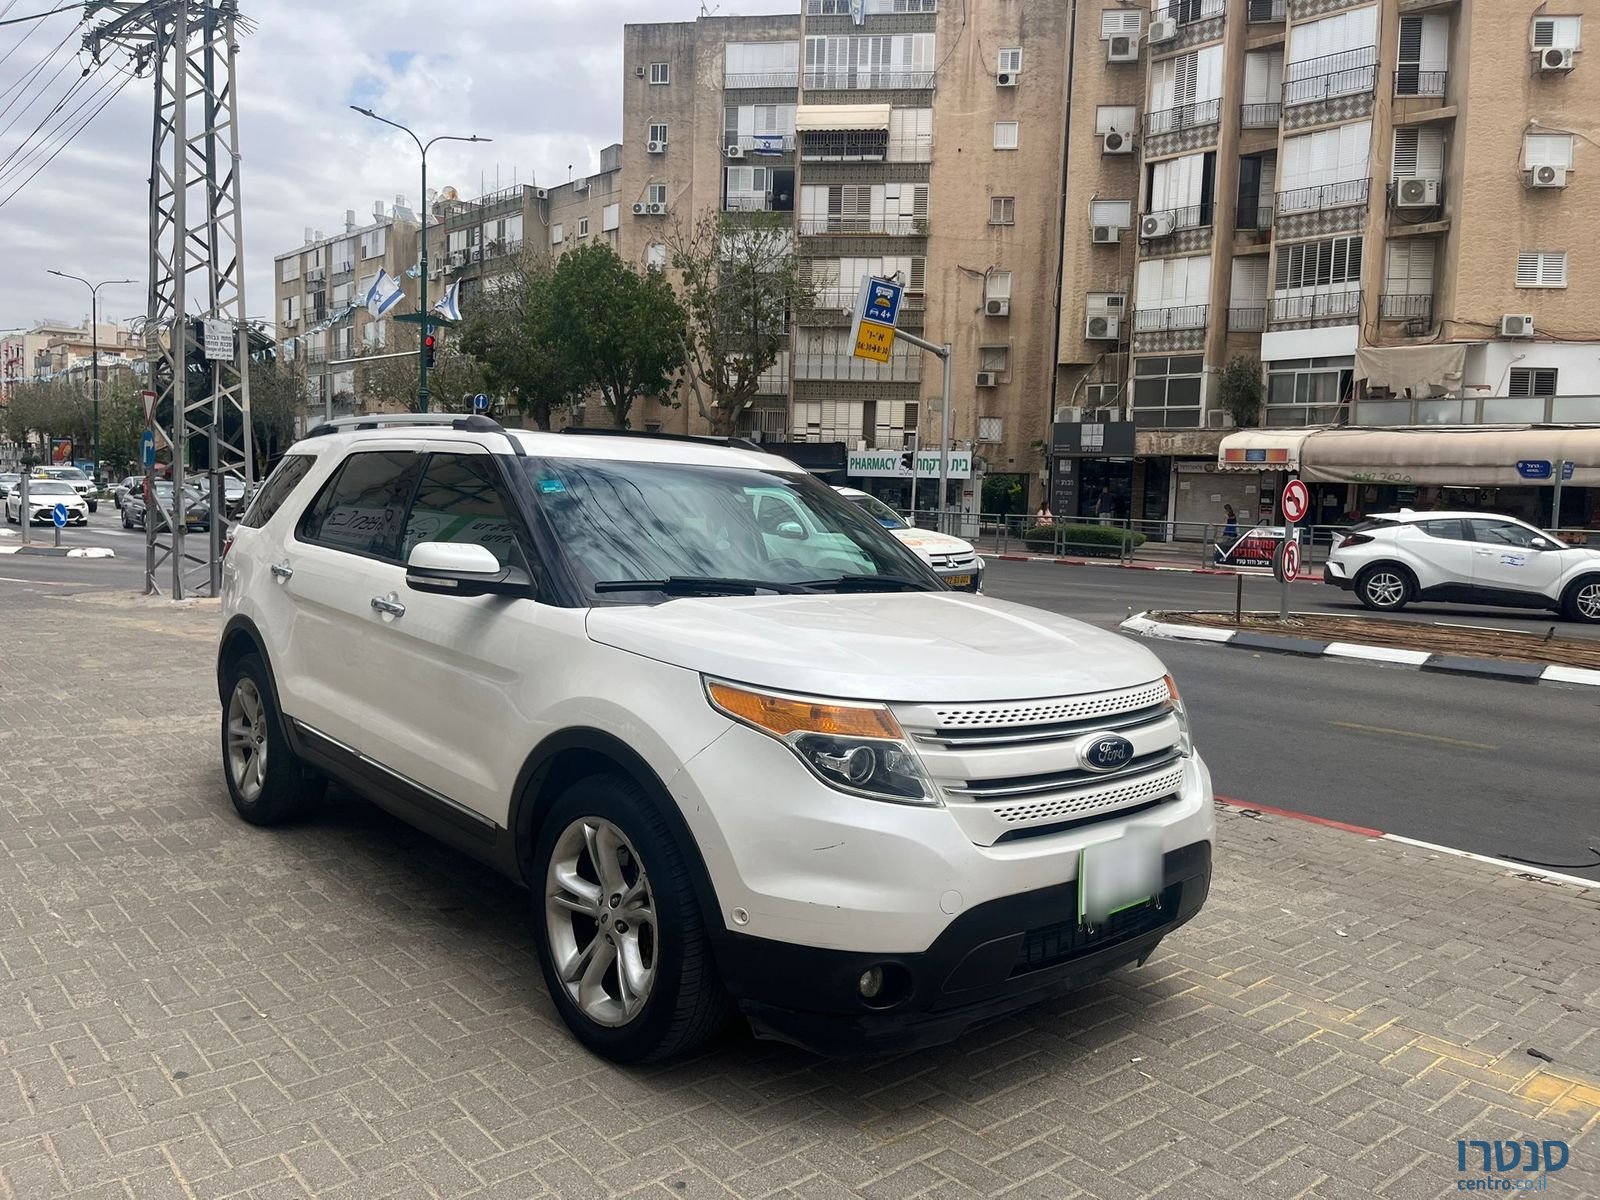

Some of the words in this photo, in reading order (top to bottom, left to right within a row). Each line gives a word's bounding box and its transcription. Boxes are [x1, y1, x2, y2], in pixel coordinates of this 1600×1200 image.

[850, 457, 897, 470] PHARMACY
[916, 458, 946, 474] רקחת
[951, 459, 968, 471] בית
[1098, 741, 1126, 763] Ford
